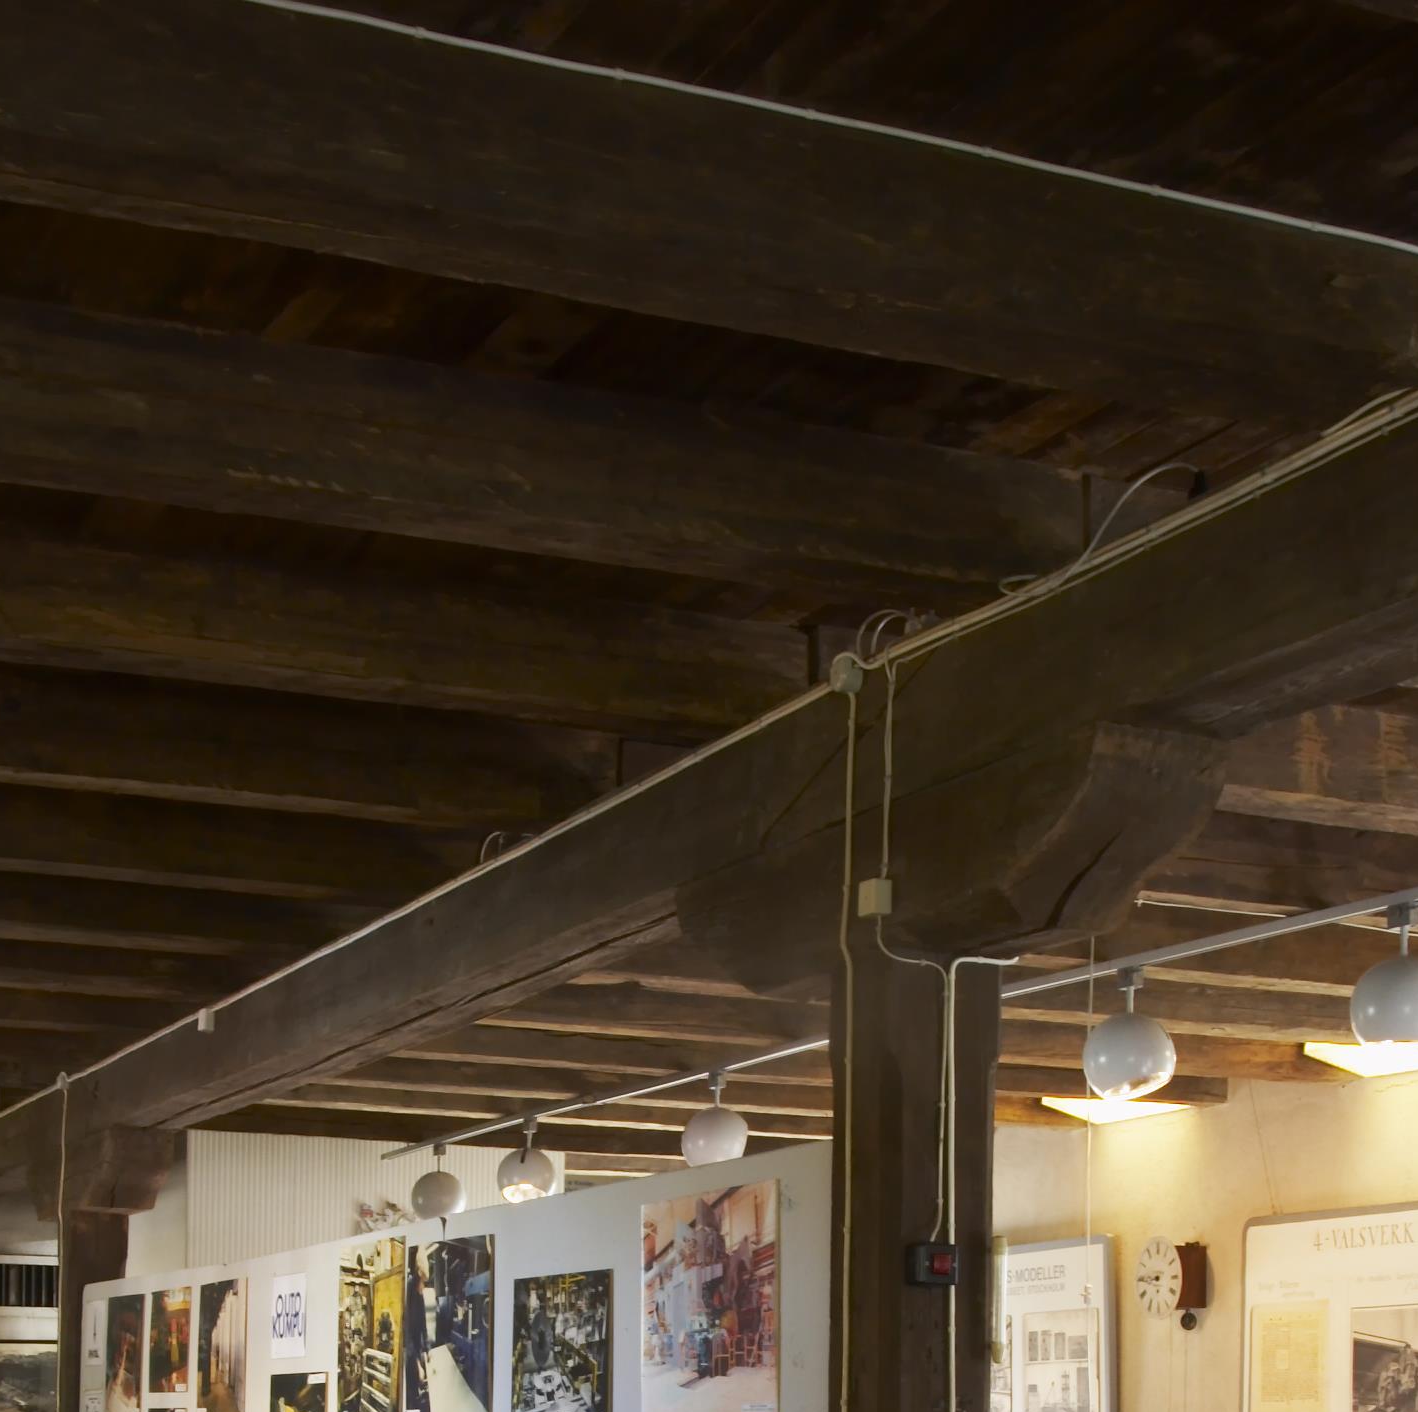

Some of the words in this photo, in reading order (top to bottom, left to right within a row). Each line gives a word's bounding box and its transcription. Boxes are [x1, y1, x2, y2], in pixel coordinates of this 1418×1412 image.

[1313, 1222, 1415, 1251] 4-VALSVERK
[276, 1292, 301, 1317] OUTO
[272, 1313, 304, 1338] KUMPU
